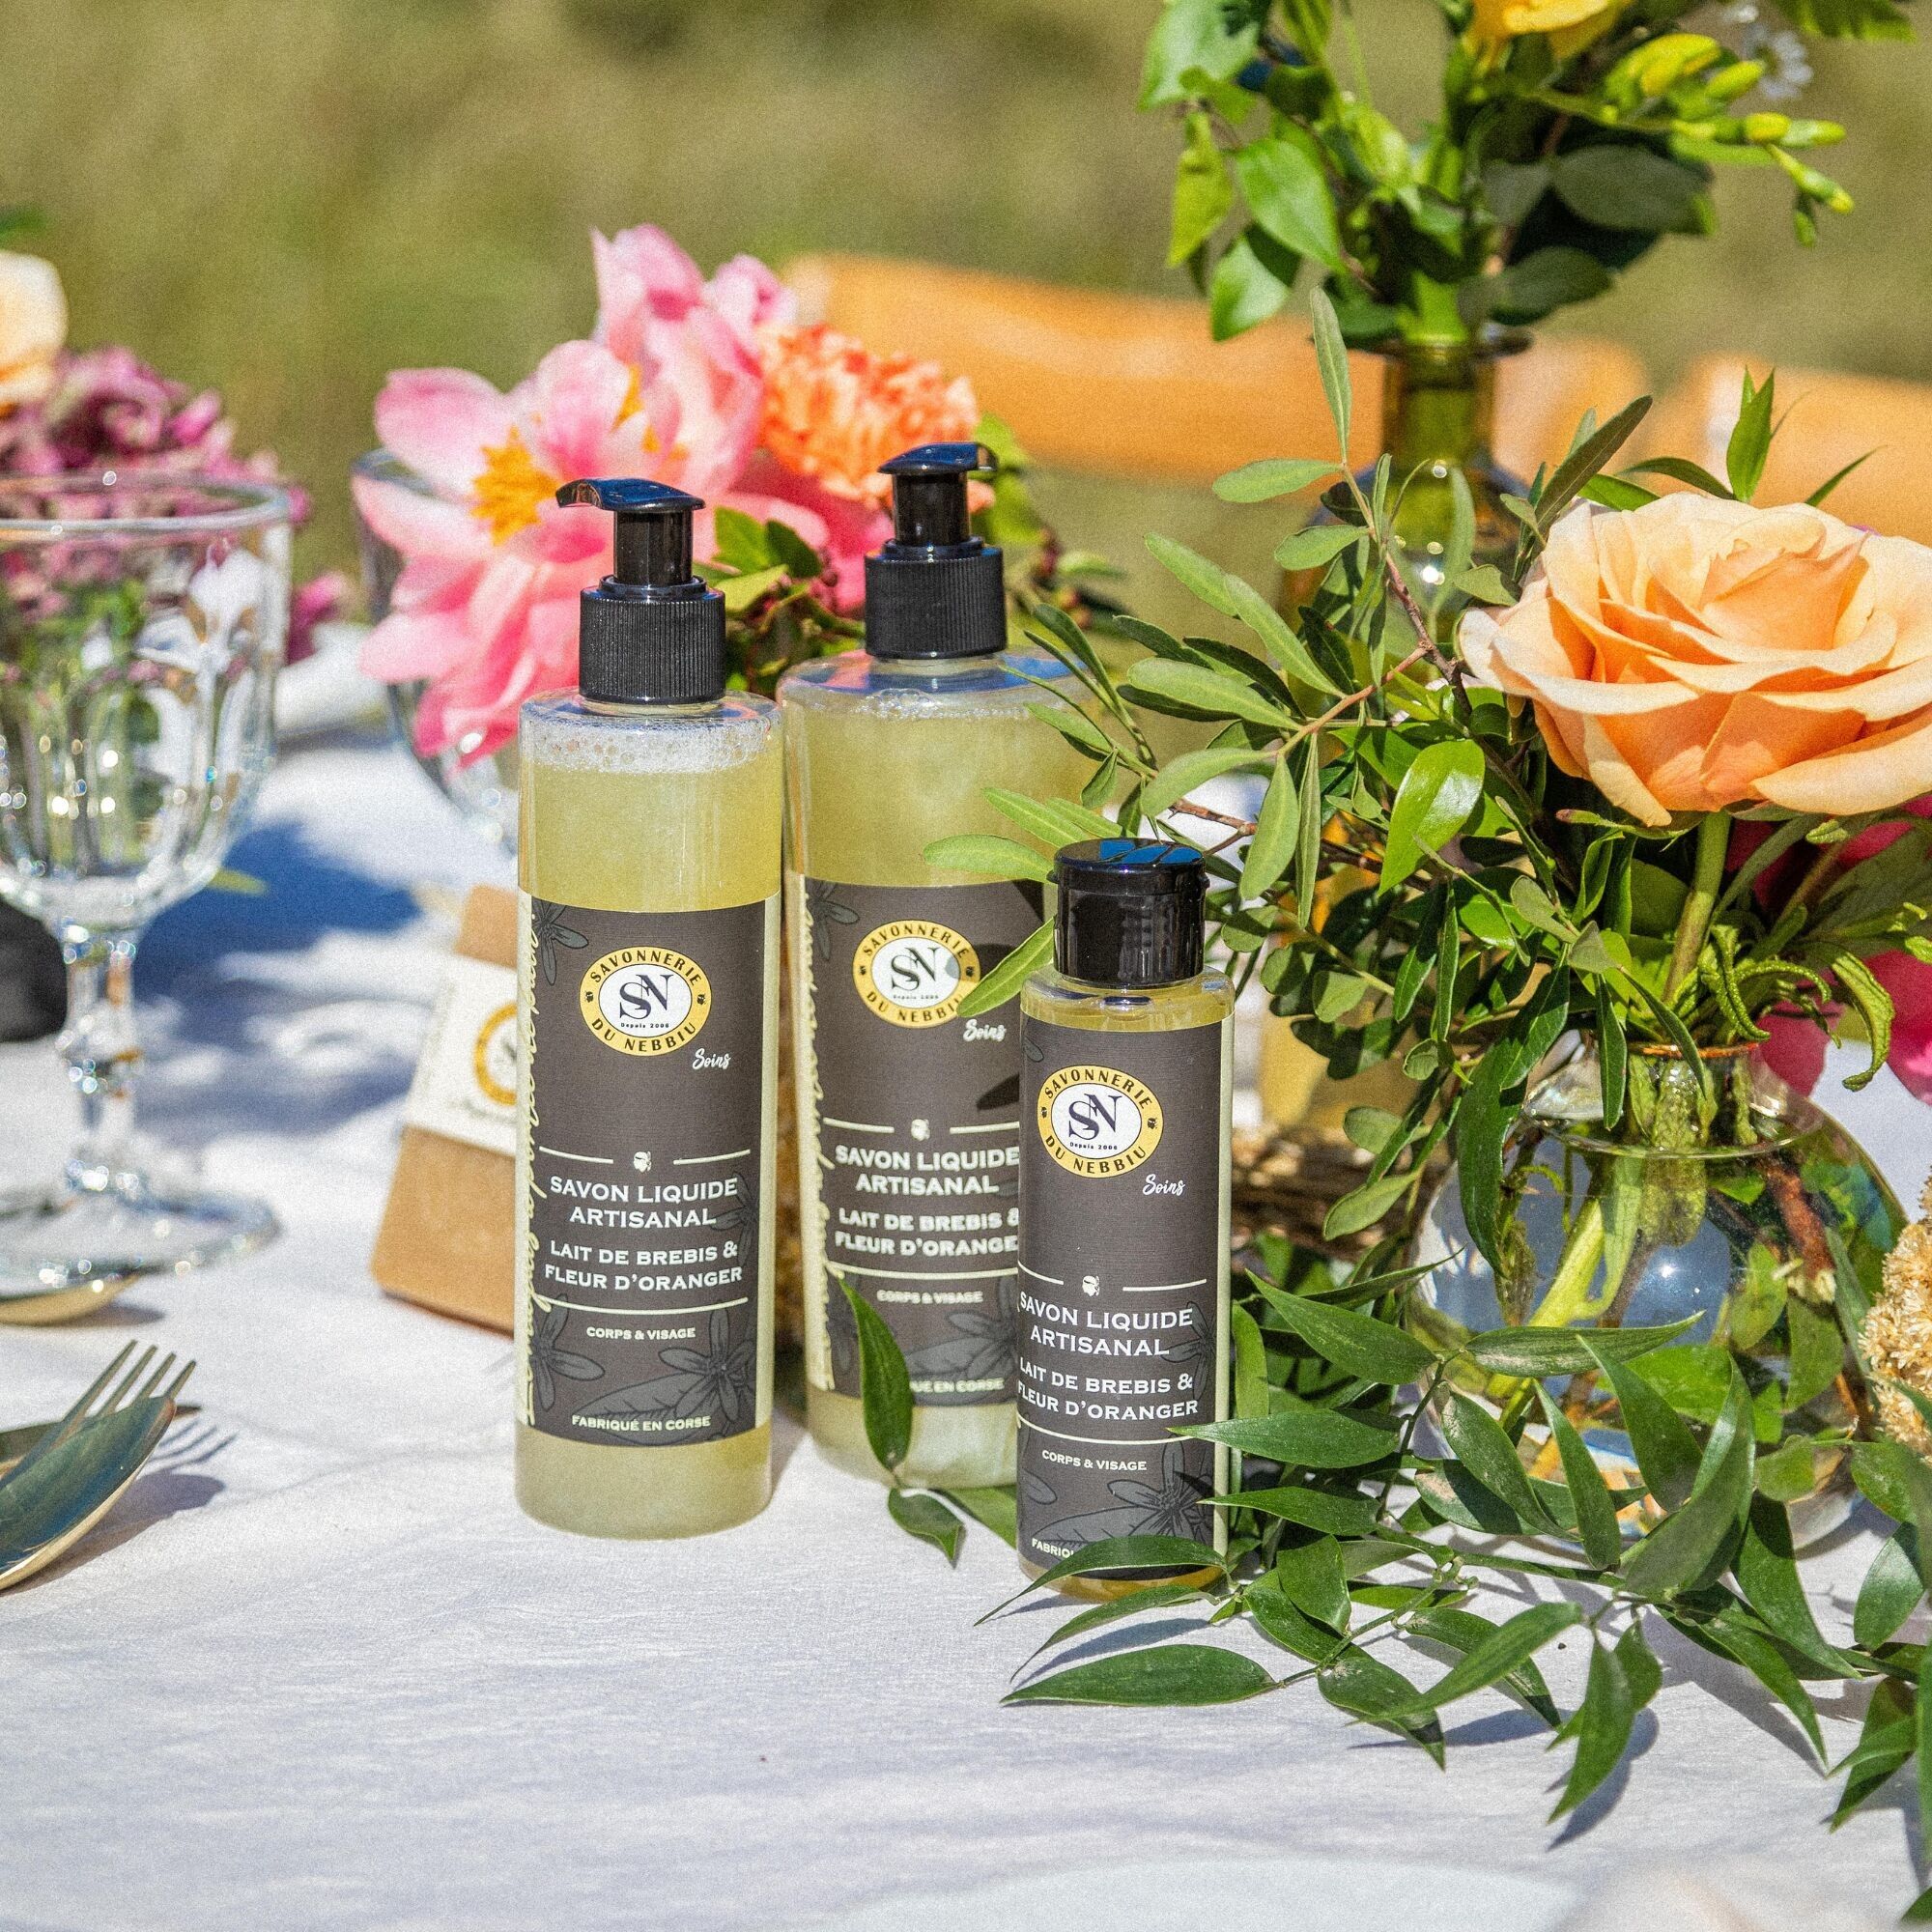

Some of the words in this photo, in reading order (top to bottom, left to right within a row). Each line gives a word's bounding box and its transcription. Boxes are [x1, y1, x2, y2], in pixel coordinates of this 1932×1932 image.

[863, 924, 971, 958] SAVONNERIE
[590, 950, 702, 986] SAVONNERIE
[867, 991, 887, 1012] DU
[591, 1017, 615, 1041] DU
[624, 1023, 696, 1052] NEBBIU
[963, 1018, 1007, 1042] Soins
[693, 1048, 731, 1069] Soins
[1044, 1068, 1152, 1110] SAVONNERIE
[835, 1144, 910, 1170] SAVON
[917, 1146, 1019, 1172] LIQUIDE
[1045, 1135, 1065, 1160] DU
[1073, 1146, 1147, 1174] NEBBIU
[550, 1176, 629, 1203] SAVON
[638, 1178, 738, 1204] LIQUIDE
[855, 1174, 1000, 1196] ARTISANAL
[1142, 1174, 1186, 1196] Soins
[569, 1207, 717, 1229] ARTISANAL
[838, 1208, 879, 1227] LAIT
[884, 1214, 914, 1231] DE
[919, 1211, 1003, 1232] BREBIS
[551, 1240, 591, 1262] LAIT
[599, 1248, 629, 1264] DE
[637, 1245, 718, 1265] BREBIS
[723, 1240, 738, 1258] &
[835, 1232, 895, 1255] FLEUR
[899, 1236, 1018, 1257] D'ORANGE
[545, 1264, 608, 1290] FLEUR
[614, 1266, 743, 1292] D'ORANGER
[932, 1292, 983, 1304] VISAGE
[1019, 1291, 1078, 1326] SAVON
[1086, 1308, 1194, 1331] LIQUIDE
[586, 1326, 632, 1340] CORPS
[635, 1329, 644, 1340] &
[646, 1327, 696, 1340] VISAGE
[1030, 1324, 1170, 1356] ARTISANAL
[1020, 1357, 1046, 1382] LAIT
[1052, 1371, 1078, 1390] DE
[1086, 1376, 1171, 1394] BREBIS
[1178, 1373, 1193, 1390] &
[1018, 1380, 1059, 1412] FLEUR
[1065, 1400, 1198, 1420] D'ORANGER
[572, 1415, 639, 1432] FABRIQUÉ
[642, 1419, 663, 1432] EN
[668, 1416, 712, 1430] CORSE
[1042, 1450, 1081, 1467] CORPS
[1084, 1459, 1094, 1469] &
[1096, 1460, 1148, 1471] VISAGE
[1032, 1538, 1074, 1558] FABRIQ
